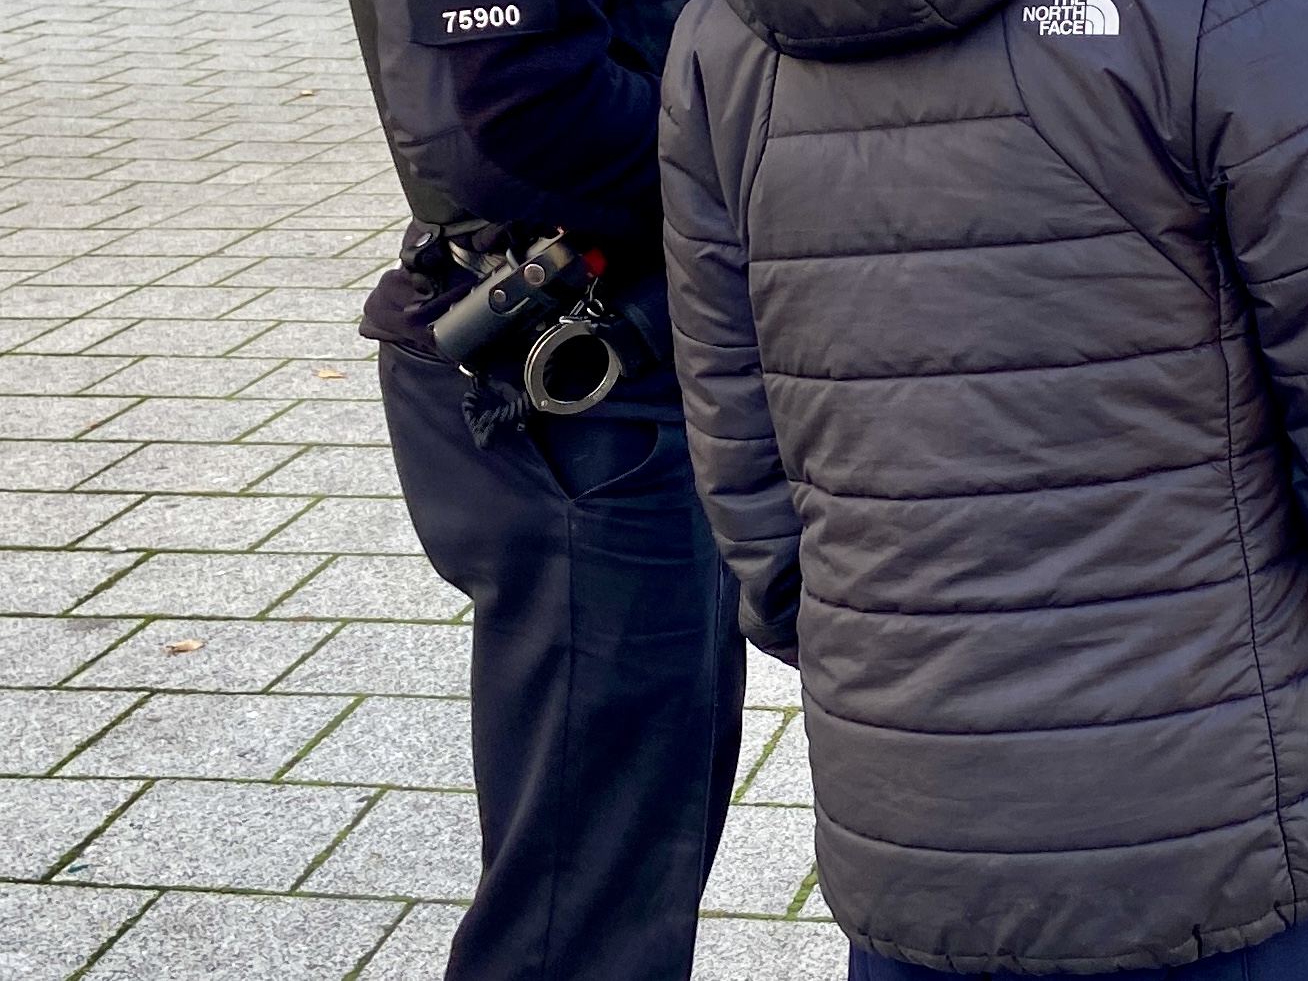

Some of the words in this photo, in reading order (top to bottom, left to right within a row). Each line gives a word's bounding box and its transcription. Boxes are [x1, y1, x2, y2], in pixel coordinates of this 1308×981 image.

[442, 4, 520, 33] 75900
[1022, 6, 1085, 22] NORTH
[1040, 20, 1085, 35] FACE
